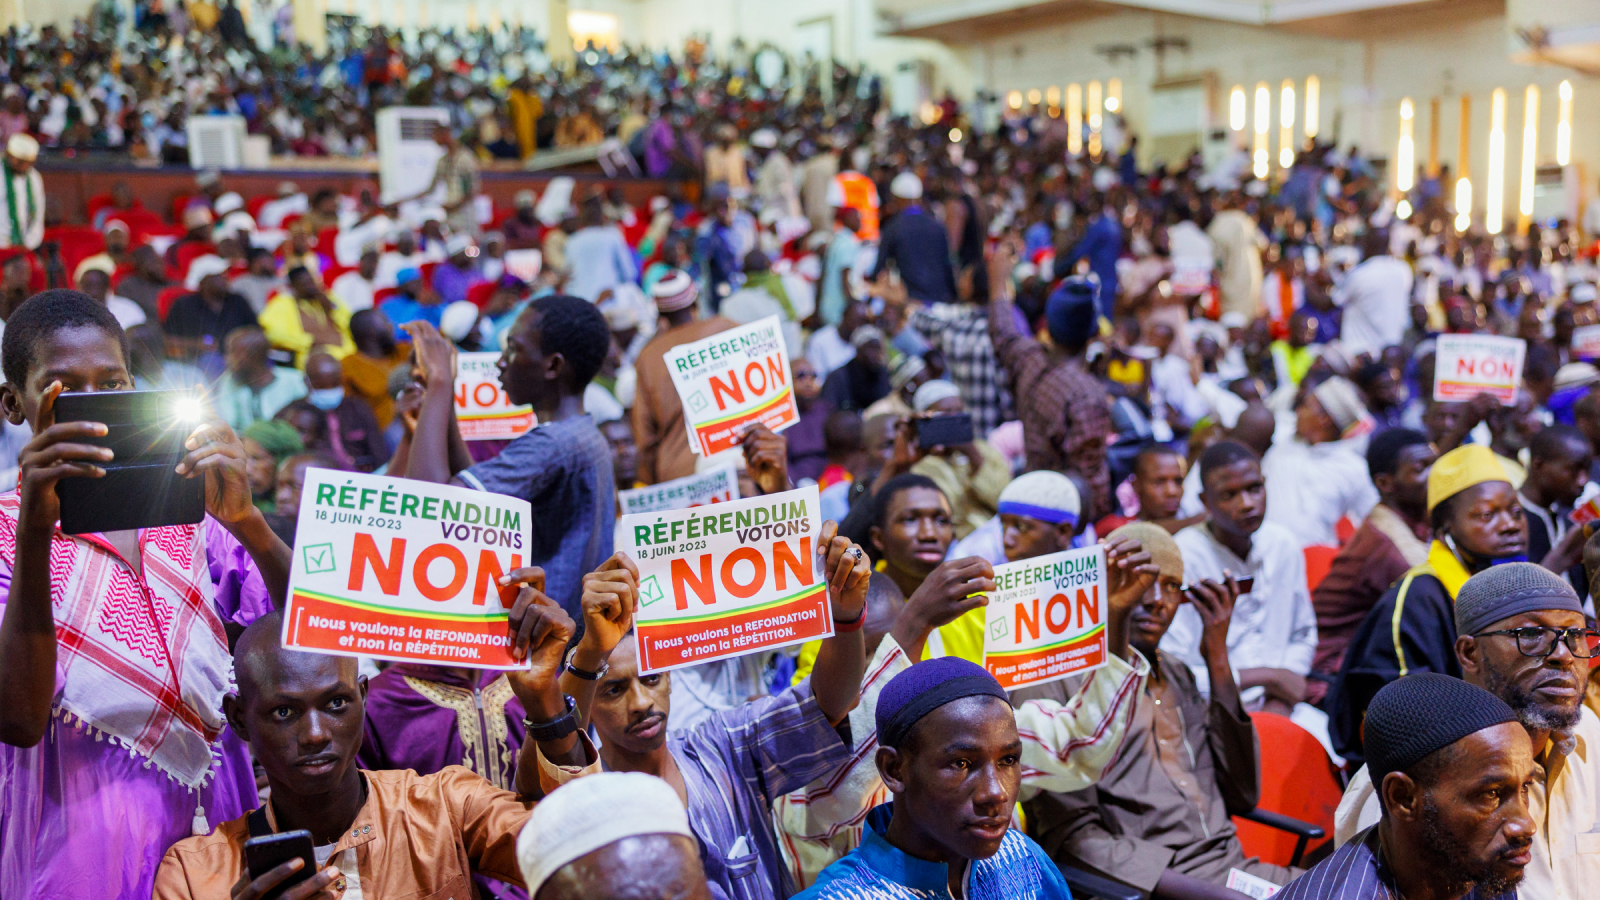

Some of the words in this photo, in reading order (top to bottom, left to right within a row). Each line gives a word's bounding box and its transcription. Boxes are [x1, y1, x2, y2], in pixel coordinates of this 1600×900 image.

[676, 327, 775, 372] RÉFÉRENDUM
[708, 352, 785, 411] NON
[1457, 358, 1514, 378] NON
[454, 383, 511, 407] NO
[315, 480, 521, 531] RÉFÉRENDUM
[315, 510, 327, 521] 18
[330, 511, 362, 525] JUIN
[367, 516, 402, 530] 2023
[441, 522, 522, 549] VOTONS
[634, 499, 807, 546] RÉFÉRENDUM
[736, 517, 810, 544] VOTONS
[637, 550, 648, 559] 18
[650, 545, 675, 560] JUIN
[679, 541, 707, 553] 2023
[348, 532, 522, 609] NON
[670, 536, 814, 611] NON
[995, 555, 1097, 591] RÉFÉRENDUM
[1054, 570, 1098, 590] VOTONS
[994, 594, 1001, 602] 18
[1002, 591, 1017, 603] JUIN
[1020, 587, 1036, 597] 2023
[654, 636, 683, 650] Nous
[686, 626, 729, 644] voulons
[731, 623, 743, 634] la
[745, 609, 817, 632] REFONDATION
[1015, 585, 1099, 644] NON
[308, 615, 346, 631] Nous
[350, 620, 405, 637] voulons
[409, 626, 422, 639] la
[425, 629, 511, 647] REFONDATION
[681, 644, 693, 658] et
[695, 643, 717, 655] non
[719, 639, 731, 651] la
[733, 627, 796, 648] RÉPÉTITION.
[339, 635, 354, 647] et
[357, 638, 388, 650] non
[389, 639, 403, 652] la
[406, 639, 481, 659] RÉPÉTITION.
[995, 663, 1016, 676] Nous
[1018, 657, 1046, 671] voulons
[1047, 654, 1054, 664] la
[1055, 643, 1100, 661] REFONDATION
[1012, 673, 1021, 682] et
[1022, 670, 1037, 680] non
[1038, 667, 1046, 676] la
